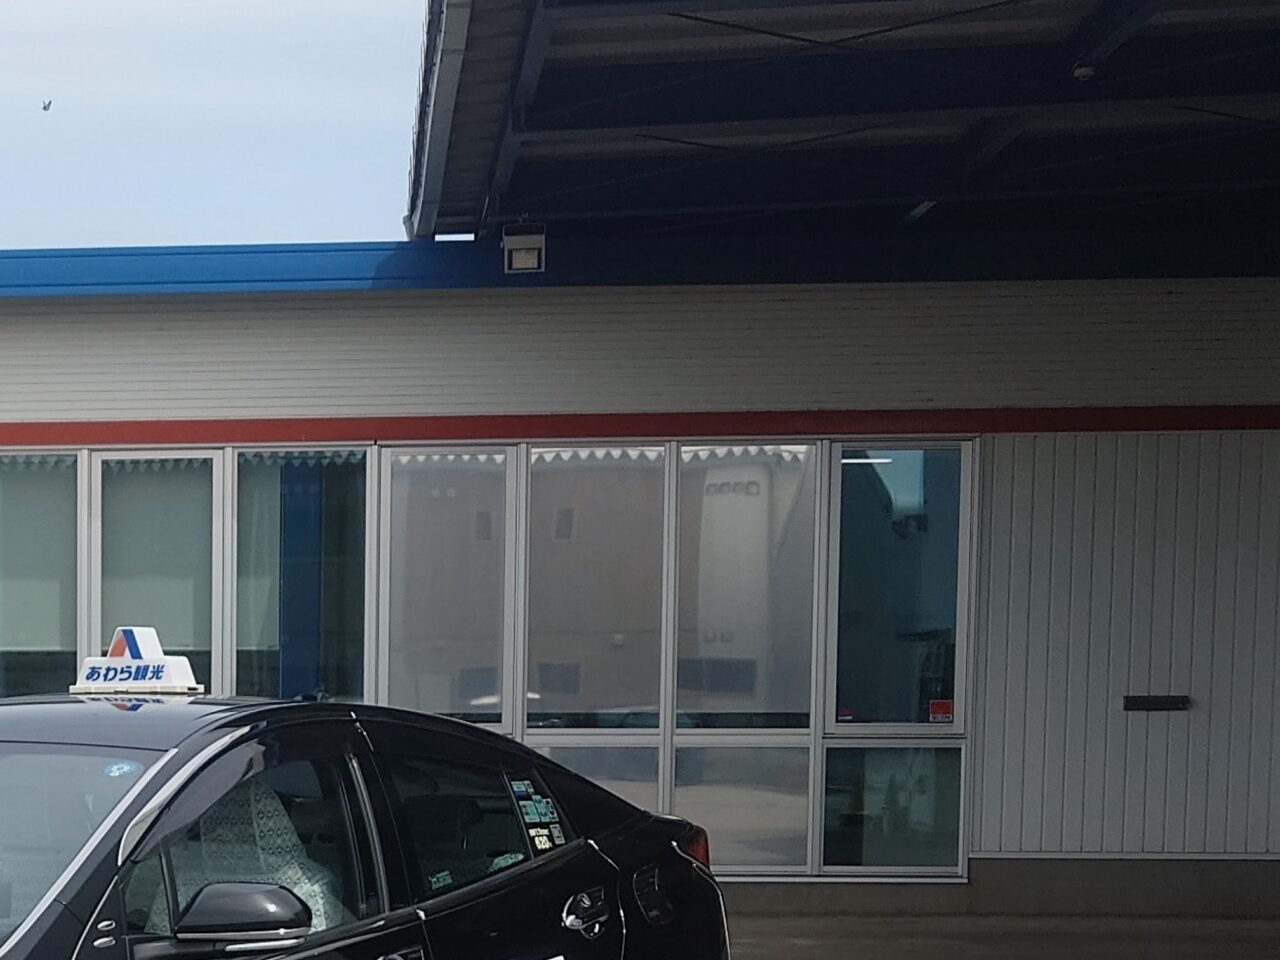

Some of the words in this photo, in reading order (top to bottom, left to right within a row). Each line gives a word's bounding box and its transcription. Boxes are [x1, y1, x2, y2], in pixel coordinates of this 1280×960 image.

[85, 664, 165, 682] あわら観光
